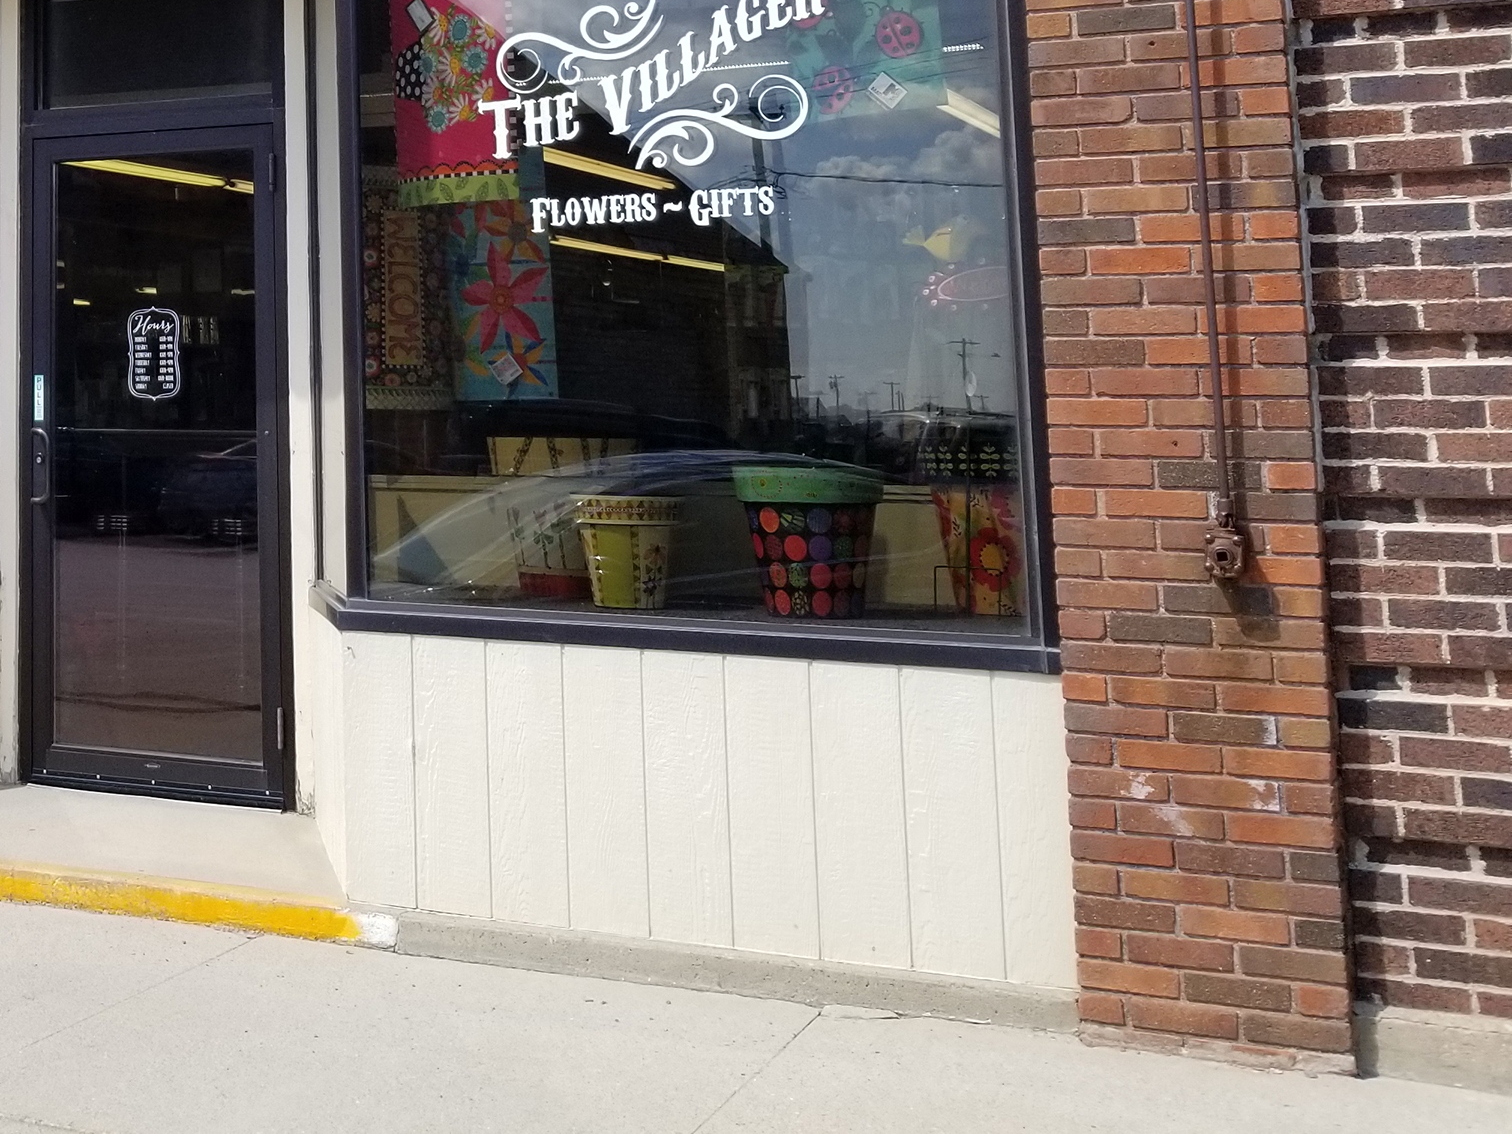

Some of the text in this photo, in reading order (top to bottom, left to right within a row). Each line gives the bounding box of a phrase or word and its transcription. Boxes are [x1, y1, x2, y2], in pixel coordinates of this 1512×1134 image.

[478, 90, 580, 160] THE
[530, 192, 657, 234] FLOWERS
[688, 185, 775, 227] GIFTS
[132, 315, 175, 336] Hours
